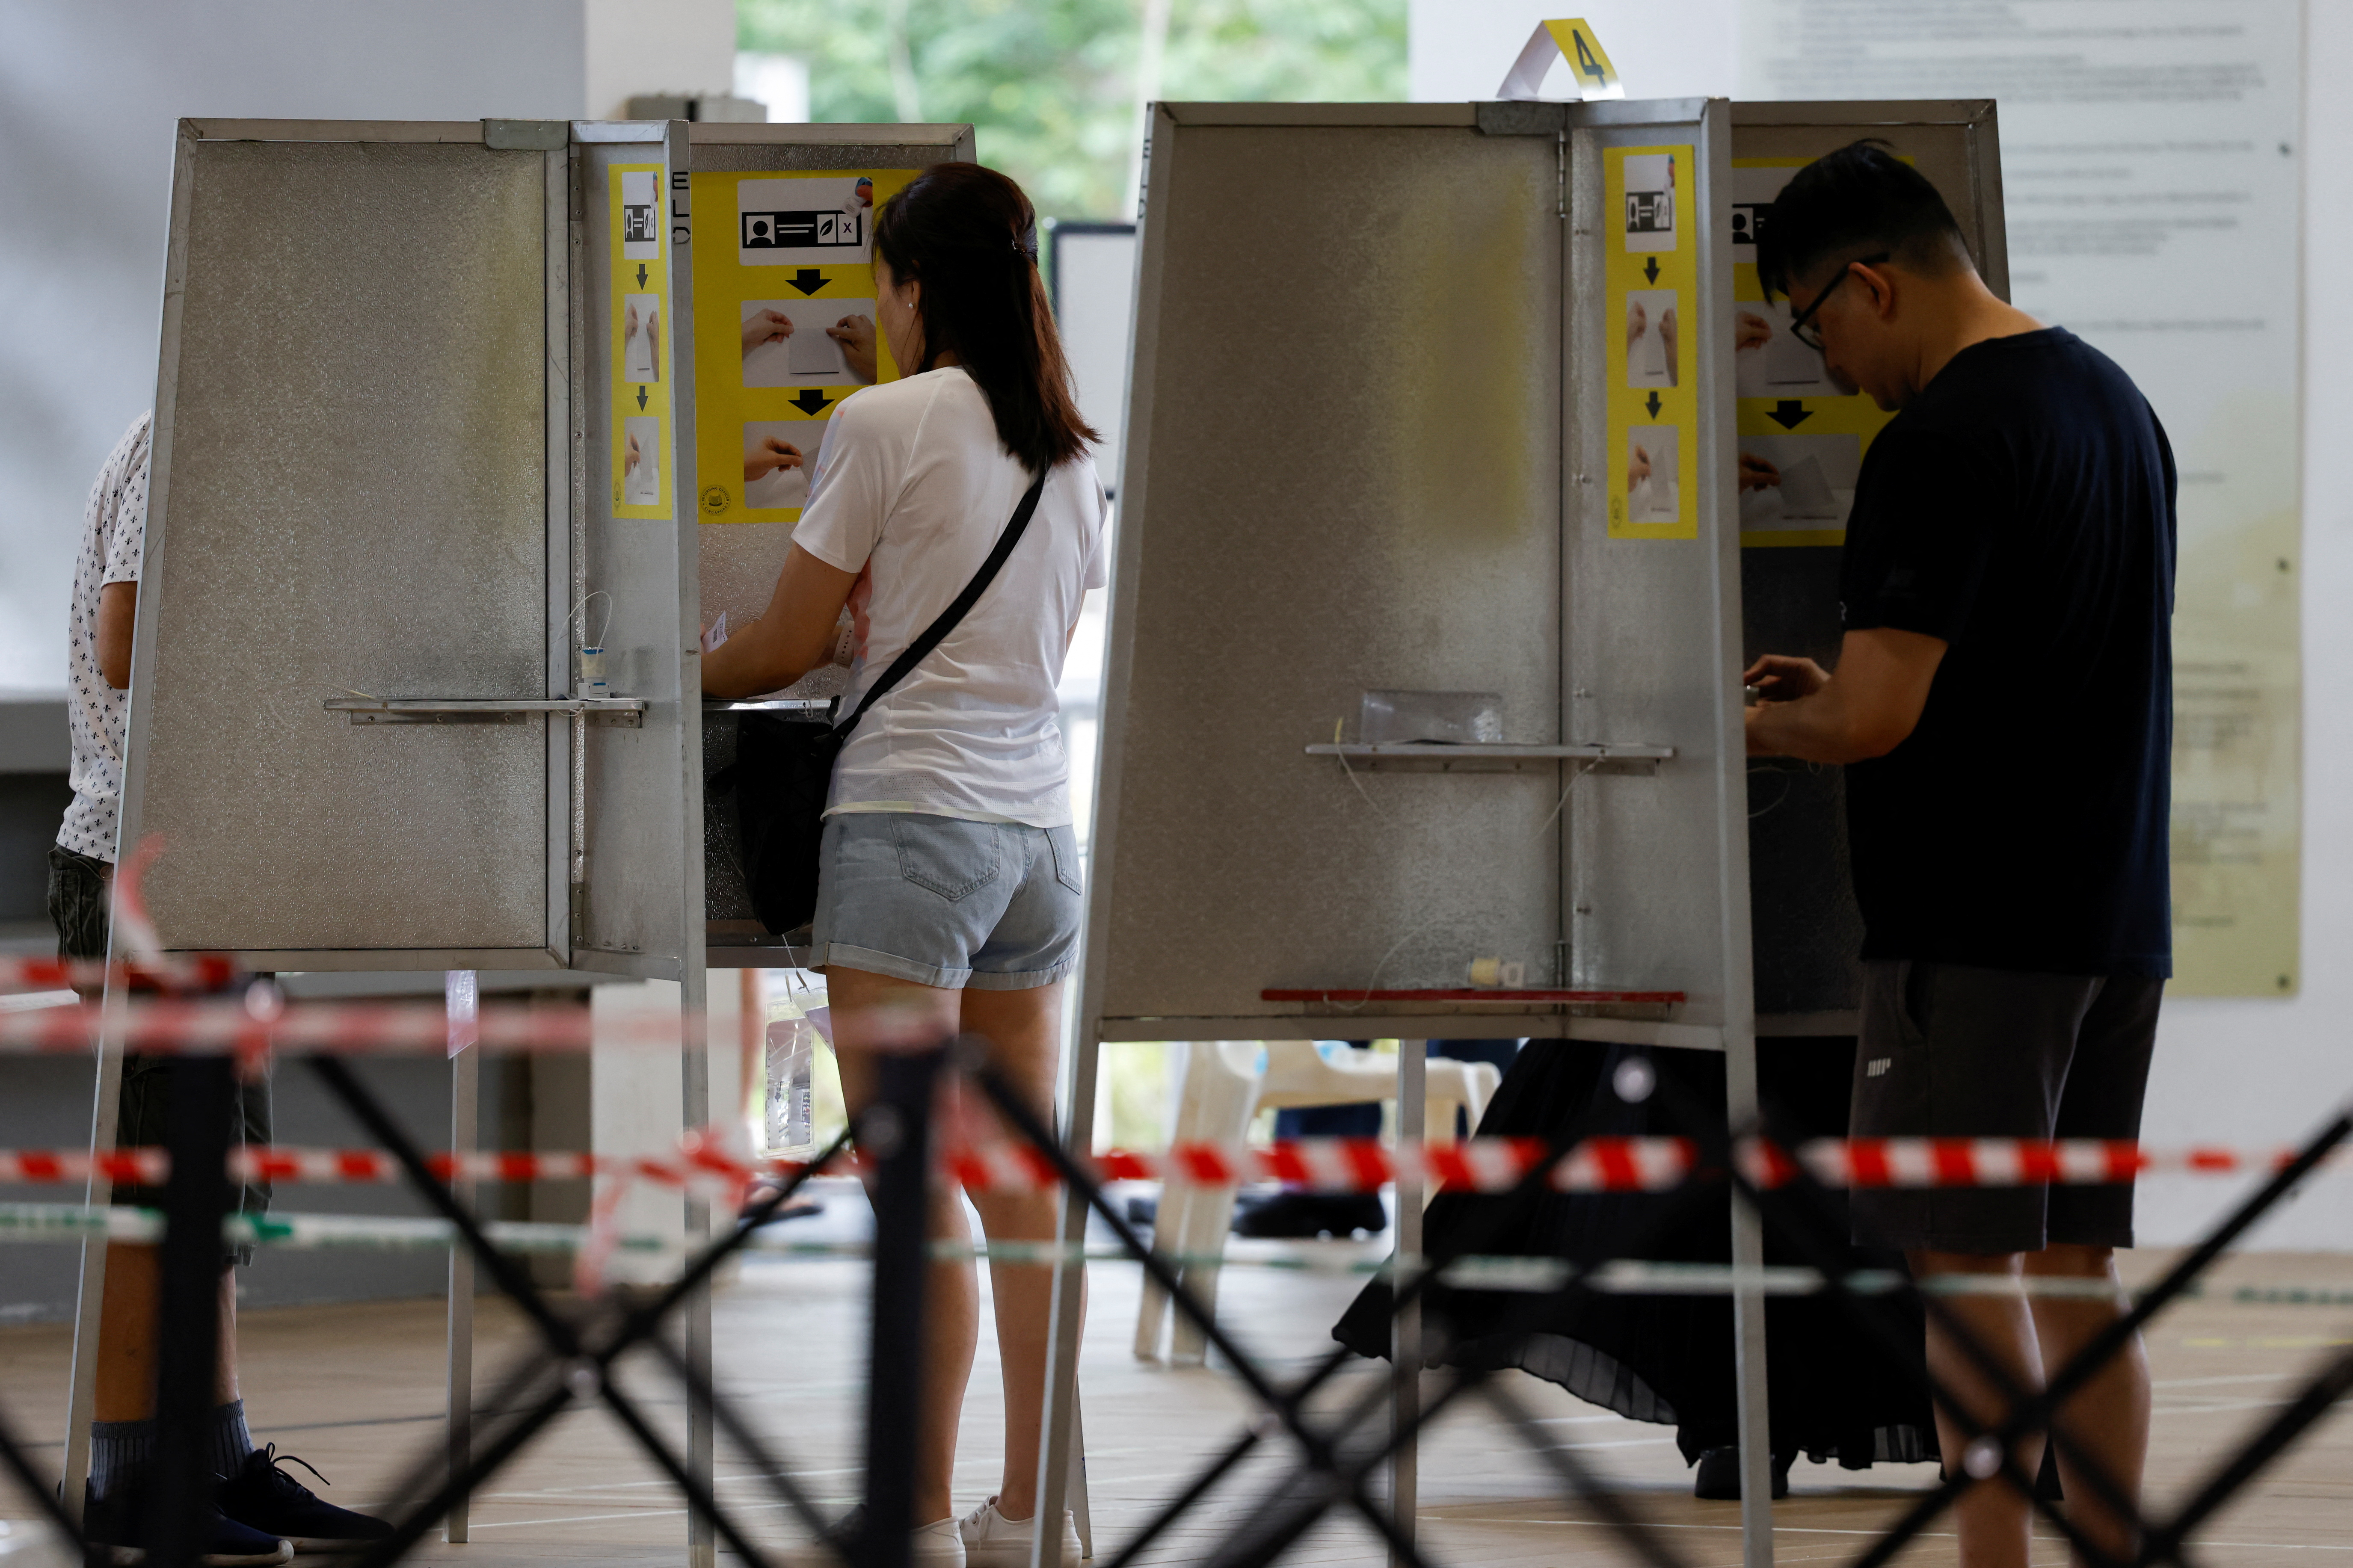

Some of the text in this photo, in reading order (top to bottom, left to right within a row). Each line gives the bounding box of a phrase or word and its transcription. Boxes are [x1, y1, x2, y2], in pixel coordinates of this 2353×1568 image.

[1573, 30, 1606, 88] 4
[673, 172, 690, 245] ELD
[843, 223, 852, 233] X
[702, 487, 729, 502] RETURNING OFFICER
[705, 505, 727, 514] SINGAPORE
